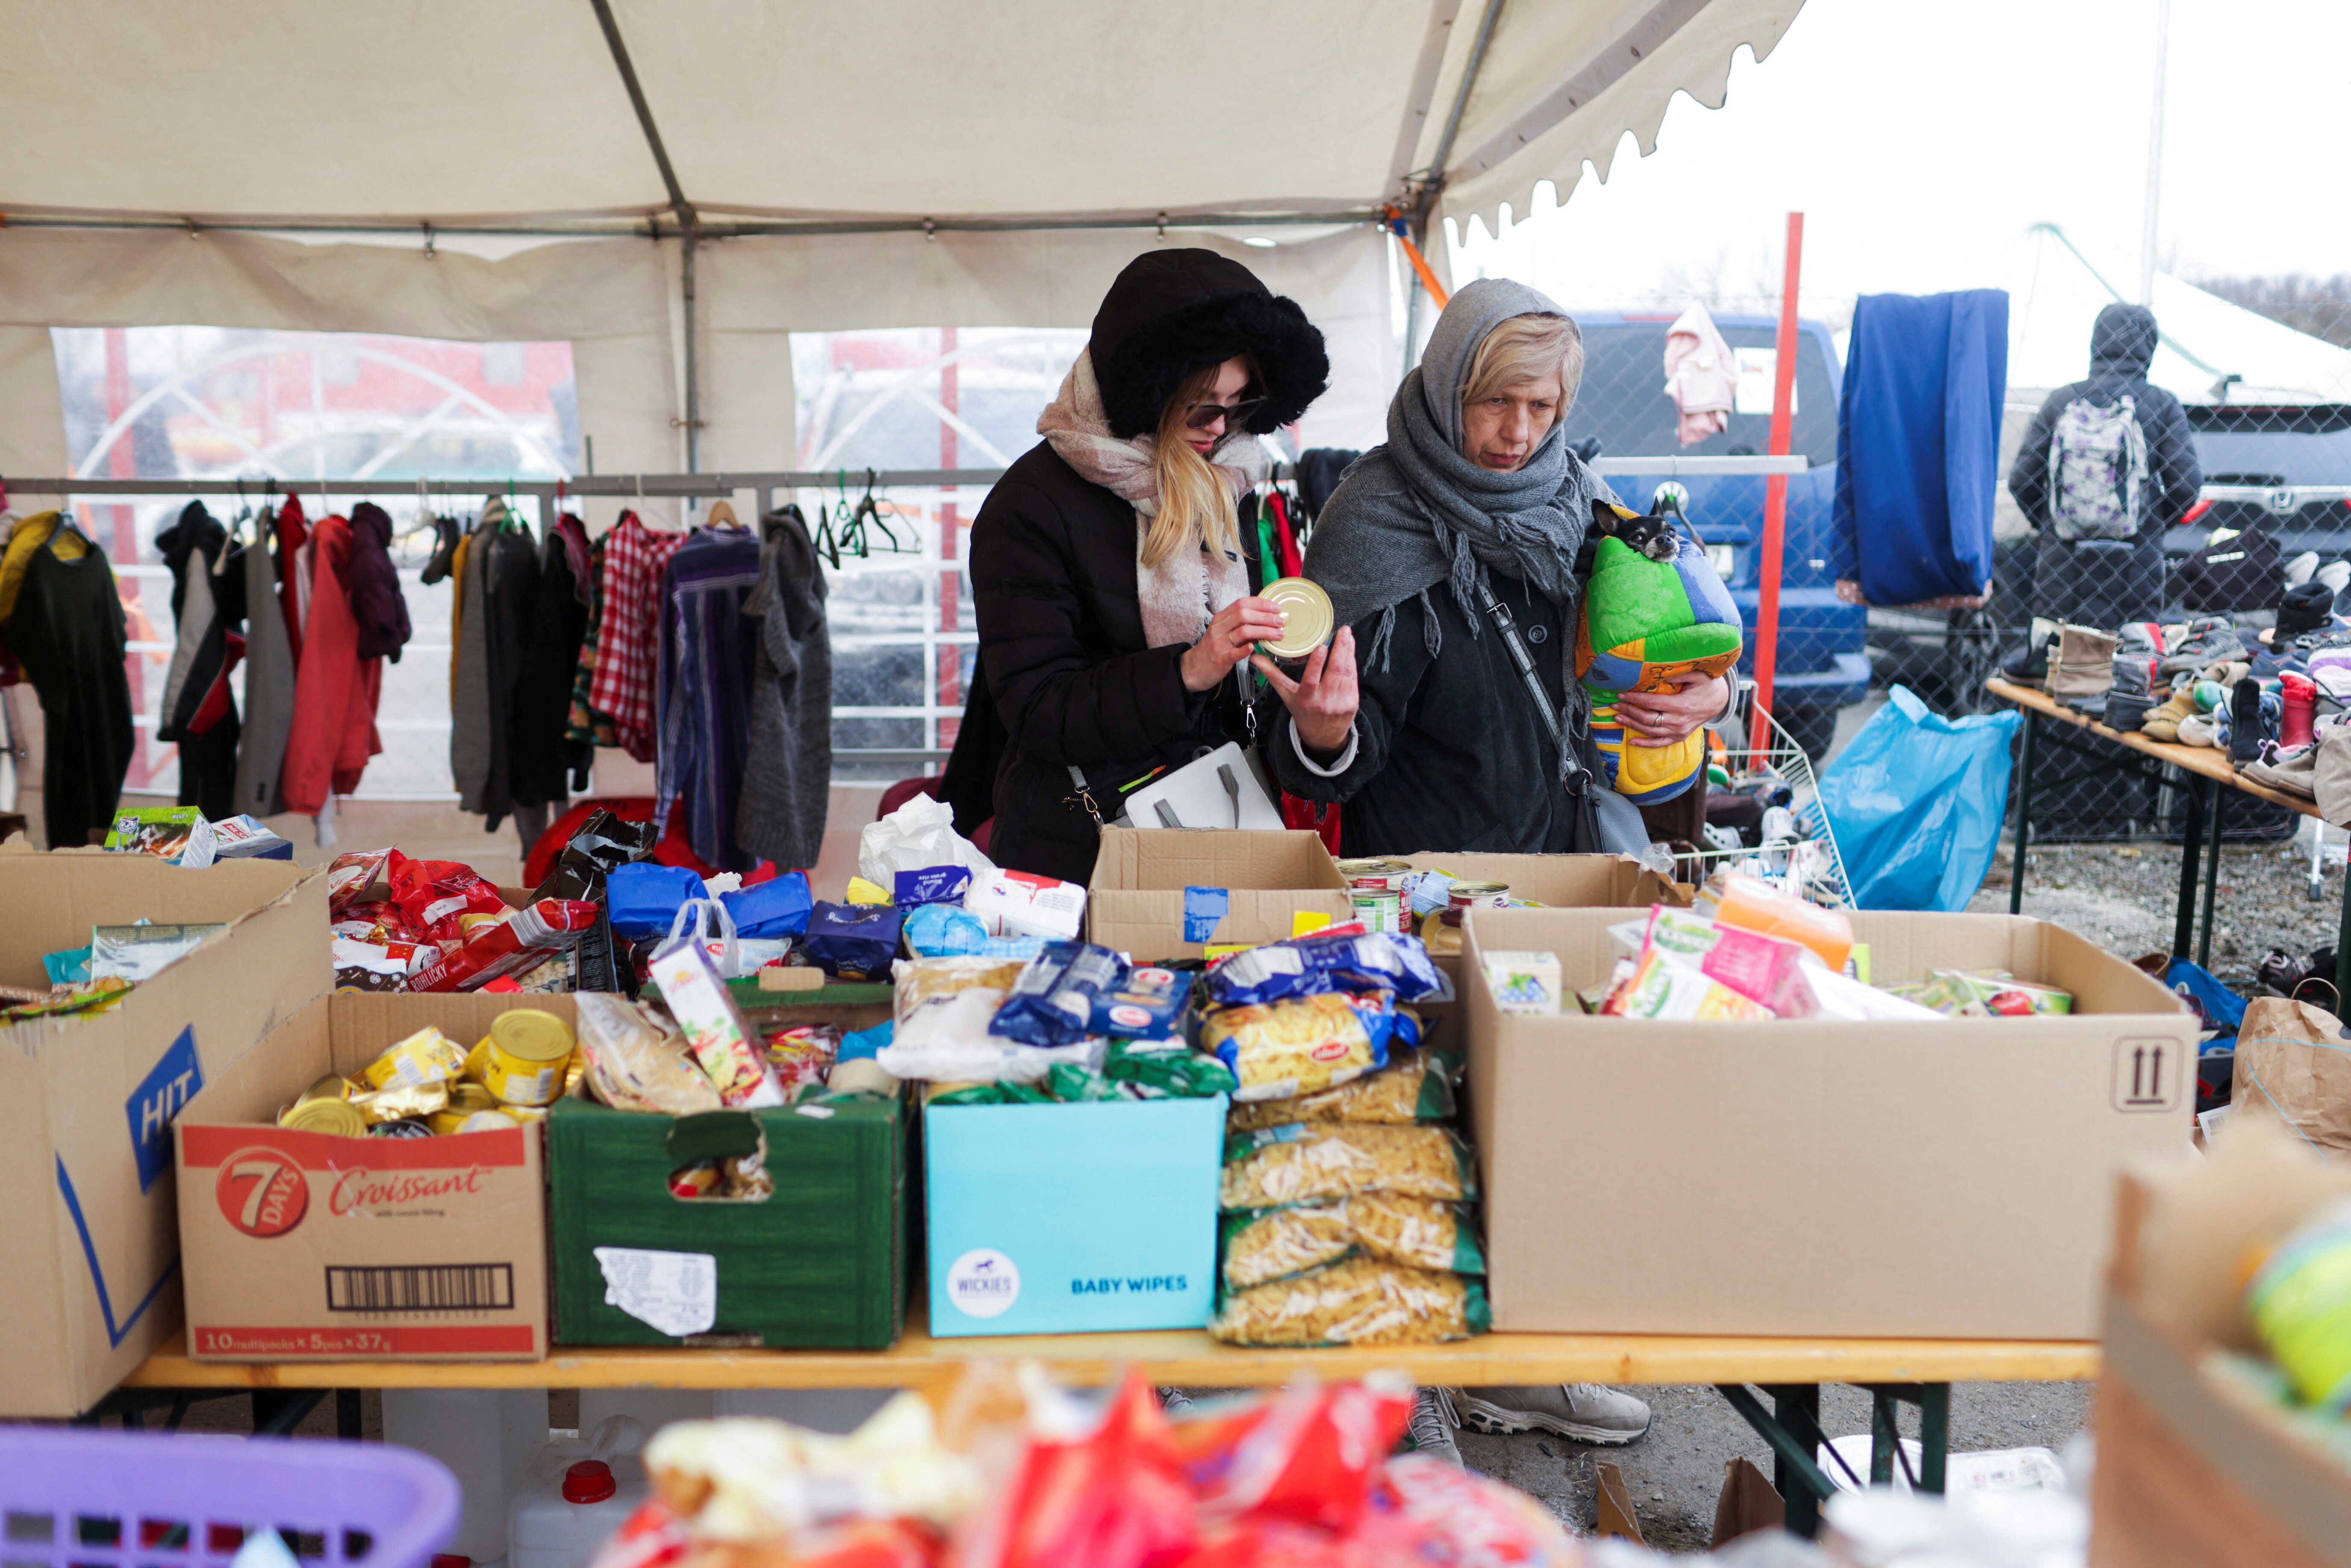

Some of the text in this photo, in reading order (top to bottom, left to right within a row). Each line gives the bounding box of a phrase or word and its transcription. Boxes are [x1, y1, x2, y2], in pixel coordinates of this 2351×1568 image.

[410, 963, 448, 993] ROHLÍČKY
[141, 1069, 194, 1146] HIT
[232, 1160, 283, 1229] 7
[261, 1167, 300, 1227] DAYS
[329, 1165, 492, 1216] Croissant
[957, 1276, 1011, 1292] WICKIES
[1071, 1275, 1188, 1295] BABY WIPES
